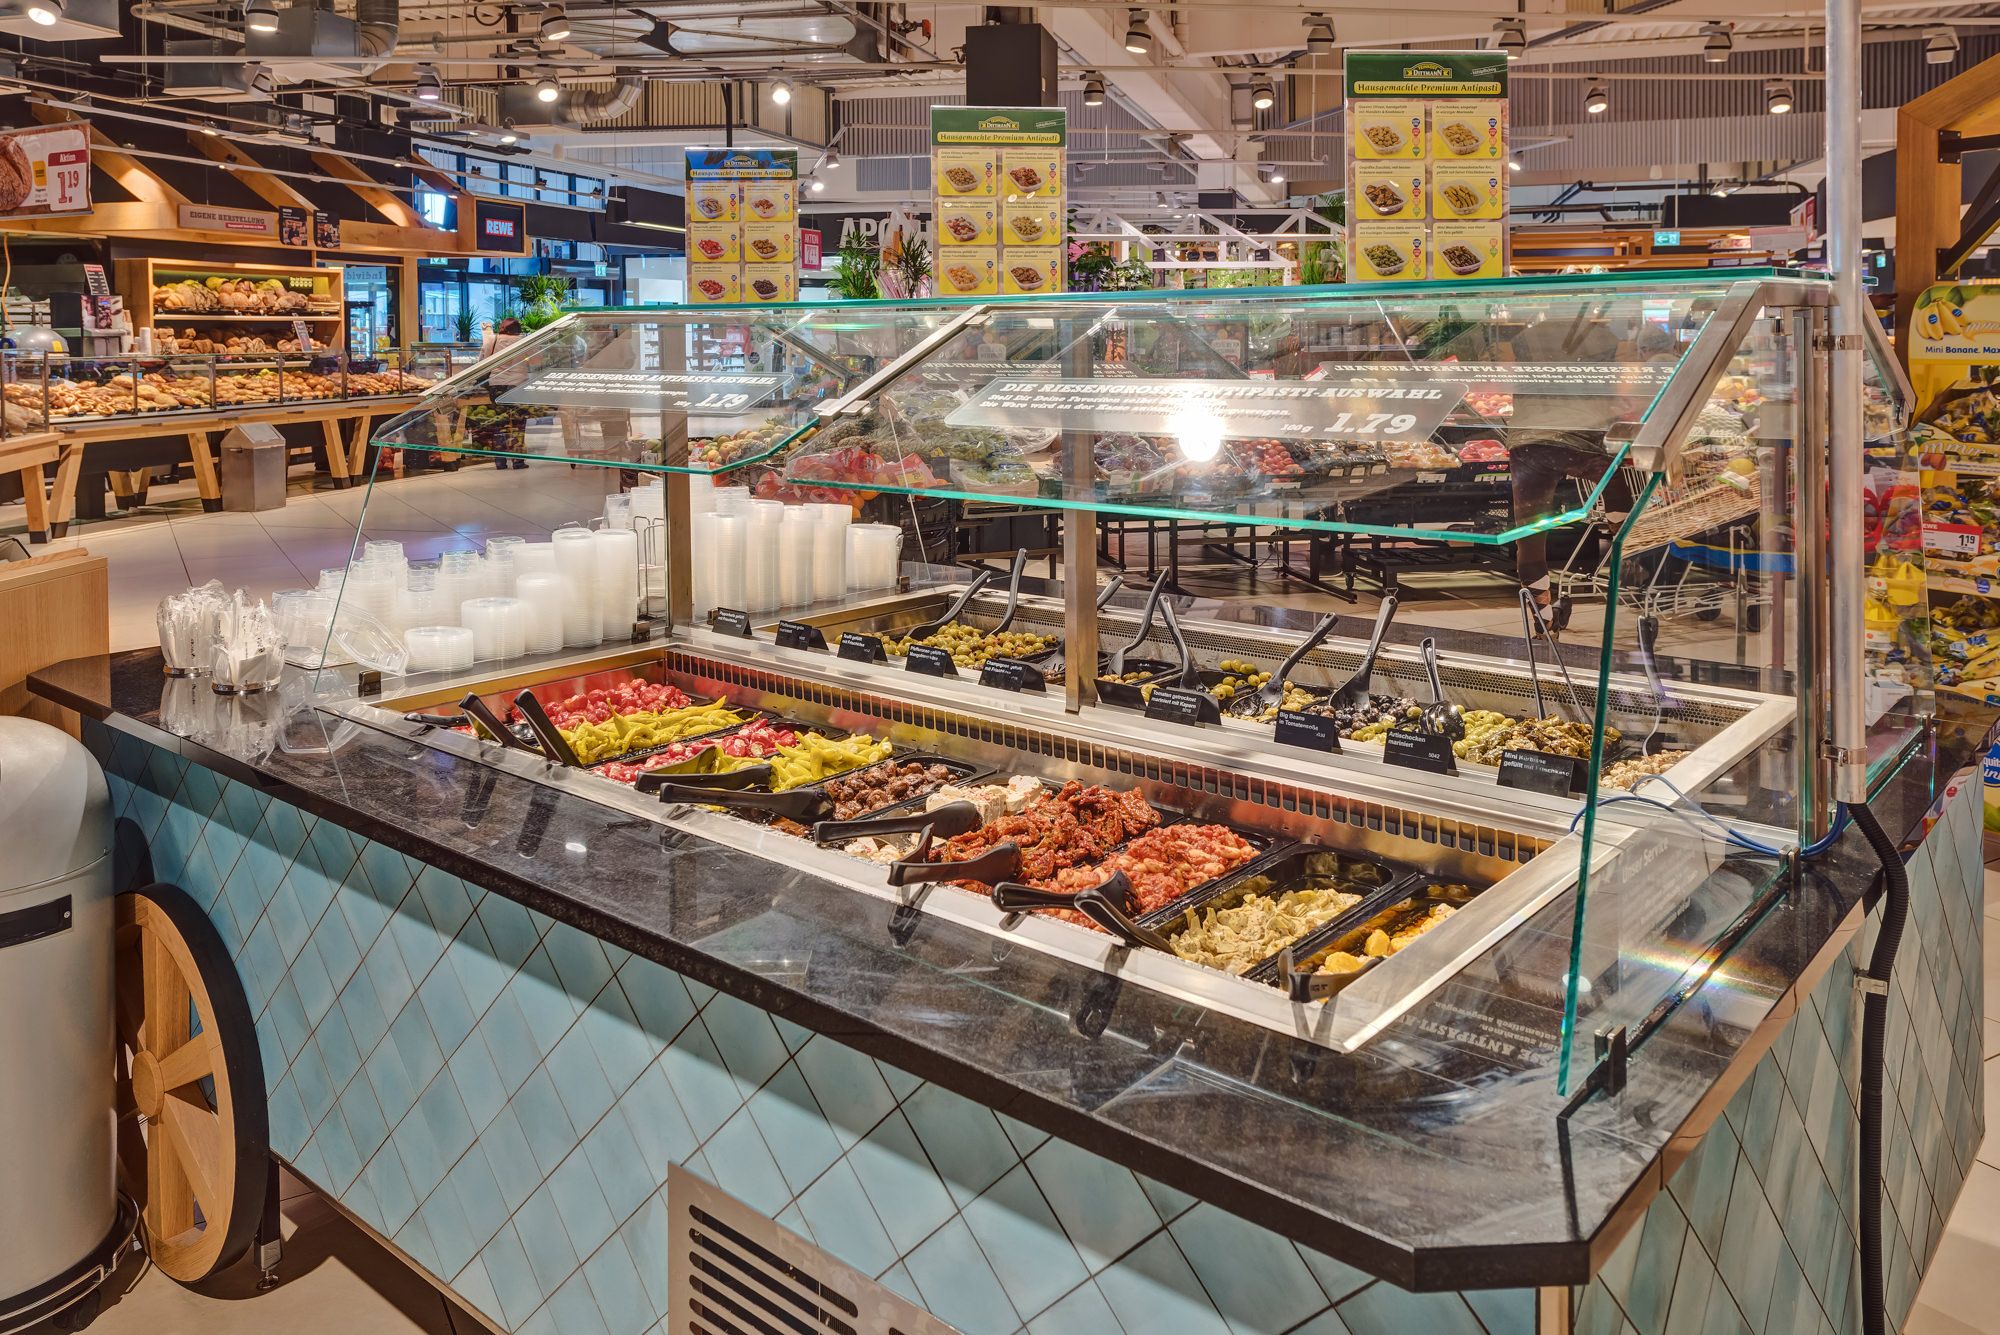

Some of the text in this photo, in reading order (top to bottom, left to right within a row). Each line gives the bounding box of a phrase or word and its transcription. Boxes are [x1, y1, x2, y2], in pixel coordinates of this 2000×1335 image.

[1358, 83, 1498, 92] Hausgemachte Premium Antipasti
[940, 133, 991, 142] Hausgemachte
[1026, 134, 1058, 142] Antipasti
[60, 153, 76, 162] Aktion
[58, 170, 79, 203] 1.19
[190, 210, 265, 225] EIGENE HERSTELLUNG
[486, 219, 513, 236] REWE
[1925, 345, 1944, 353] Mini
[648, 373, 778, 385] ANTIPASTI-AUSWAHL
[1000, 383, 1038, 392] DIE
[695, 393, 750, 409] 1.79
[1067, 395, 1121, 403] Favoriten
[1281, 423, 1313, 433] 100g
[1324, 412, 1417, 434] 1.79
[1959, 534, 1976, 547] 1.19
[1153, 689, 1197, 703] Tomaten getrocknet
[1151, 696, 1171, 705] mariniert
[1180, 702, 1197, 710] Kapern
[1280, 711, 1306, 721] Big Beans
[1285, 720, 1319, 731] Tomatensoße
[1388, 731, 1426, 743] Artischocken
[1388, 739, 1414, 748] mariniert
[1428, 752, 1441, 760] 5042
[1504, 752, 1518, 760] Mini
[1503, 760, 1524, 769] gefüllt
[1401, 1013, 1516, 1056] ANTIPASTI-A
